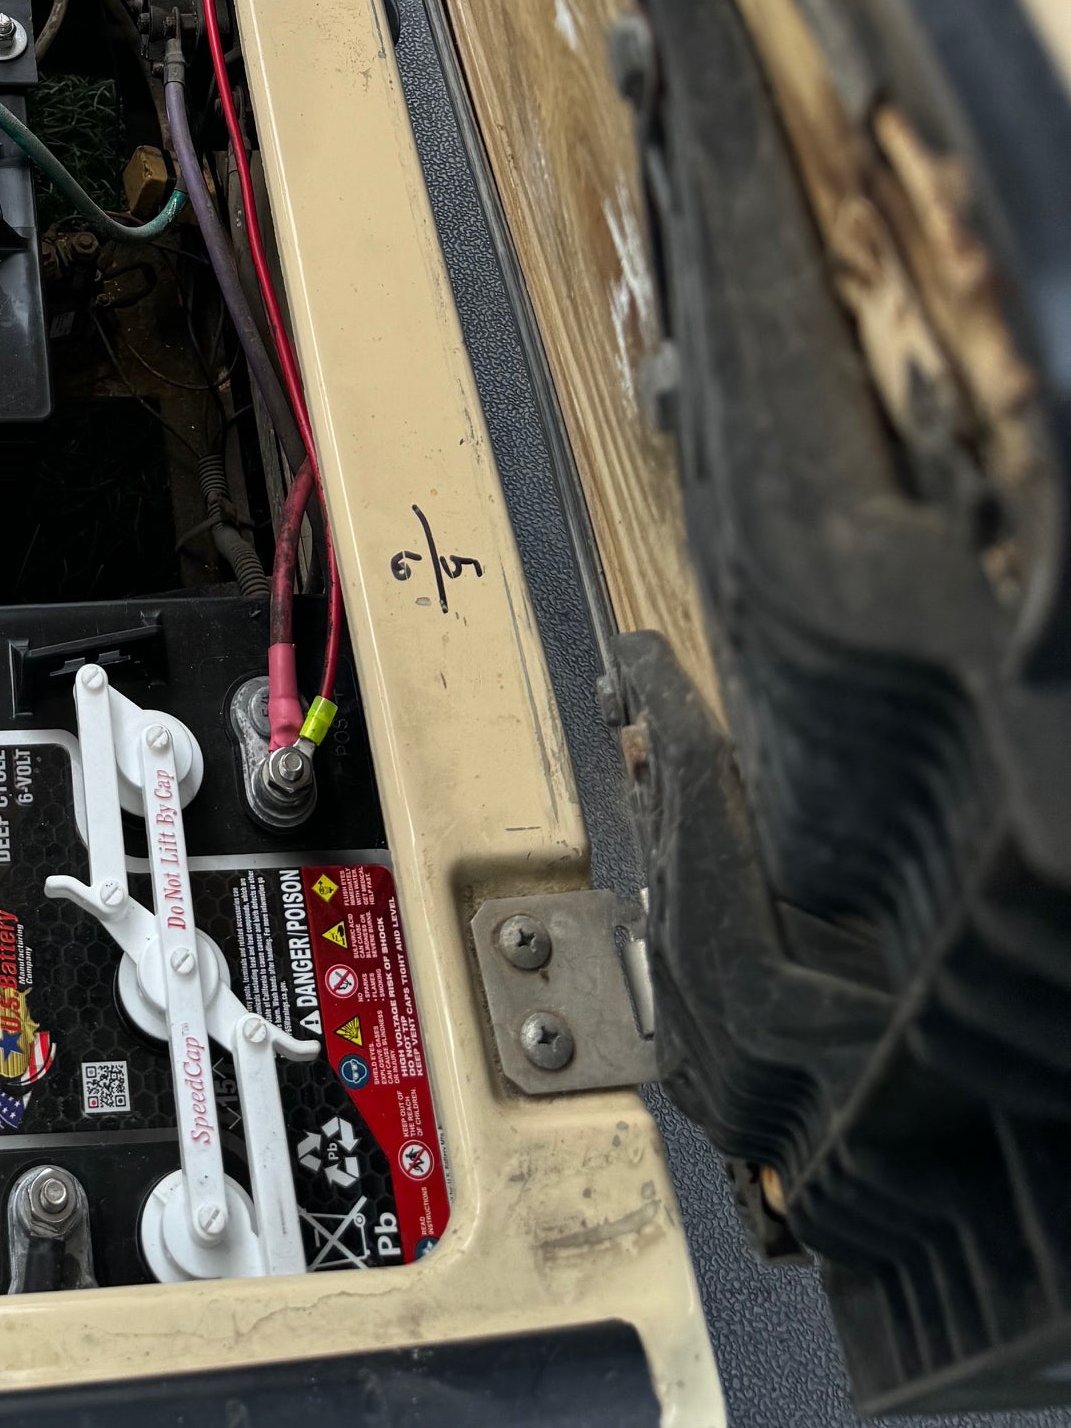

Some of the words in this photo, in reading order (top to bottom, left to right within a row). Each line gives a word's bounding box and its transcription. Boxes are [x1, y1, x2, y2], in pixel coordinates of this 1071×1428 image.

[14, 748, 34, 804] 6-VOLT
[154, 768, 177, 799] Cap
[157, 807, 179, 824] By
[159, 832, 182, 864] Lift
[163, 872, 185, 901] Not
[166, 905, 188, 930] Do
[388, 896, 400, 927] LEVEL
[279, 869, 319, 1008] DANGER/POISON
[376, 917, 389, 953] SHOCK
[393, 929, 404, 951] AND
[17, 923, 27, 985] Manufacturing
[25, 946, 34, 985] Company
[382, 955, 391, 970] OF
[397, 953, 409, 984] TIGHT
[384, 972, 396, 997] RISK
[402, 987, 414, 1014] CAPS
[389, 999, 404, 1046] VOLTAGE
[400, 1015, 410, 1032] TIP
[407, 1016, 419, 1045] VENT
[403, 1034, 414, 1057] NOT
[397, 1049, 408, 1077] HIGH
[407, 1059, 417, 1076] DO
[412, 1047, 424, 1076] KEEP
[396, 1090, 404, 1100] OF
[404, 1096, 414, 1121] REACH
[398, 1102, 407, 1116] OUT
[400, 1117, 410, 1137] KEEP
[408, 1122, 416, 1136] THE
[416, 1126, 424, 1136] OF
[327, 1142, 339, 1160] Pb
[421, 1186, 435, 1234] INSTRUCTIONS
[374, 1212, 401, 1256] Pb
[419, 1216, 428, 1235] READ
